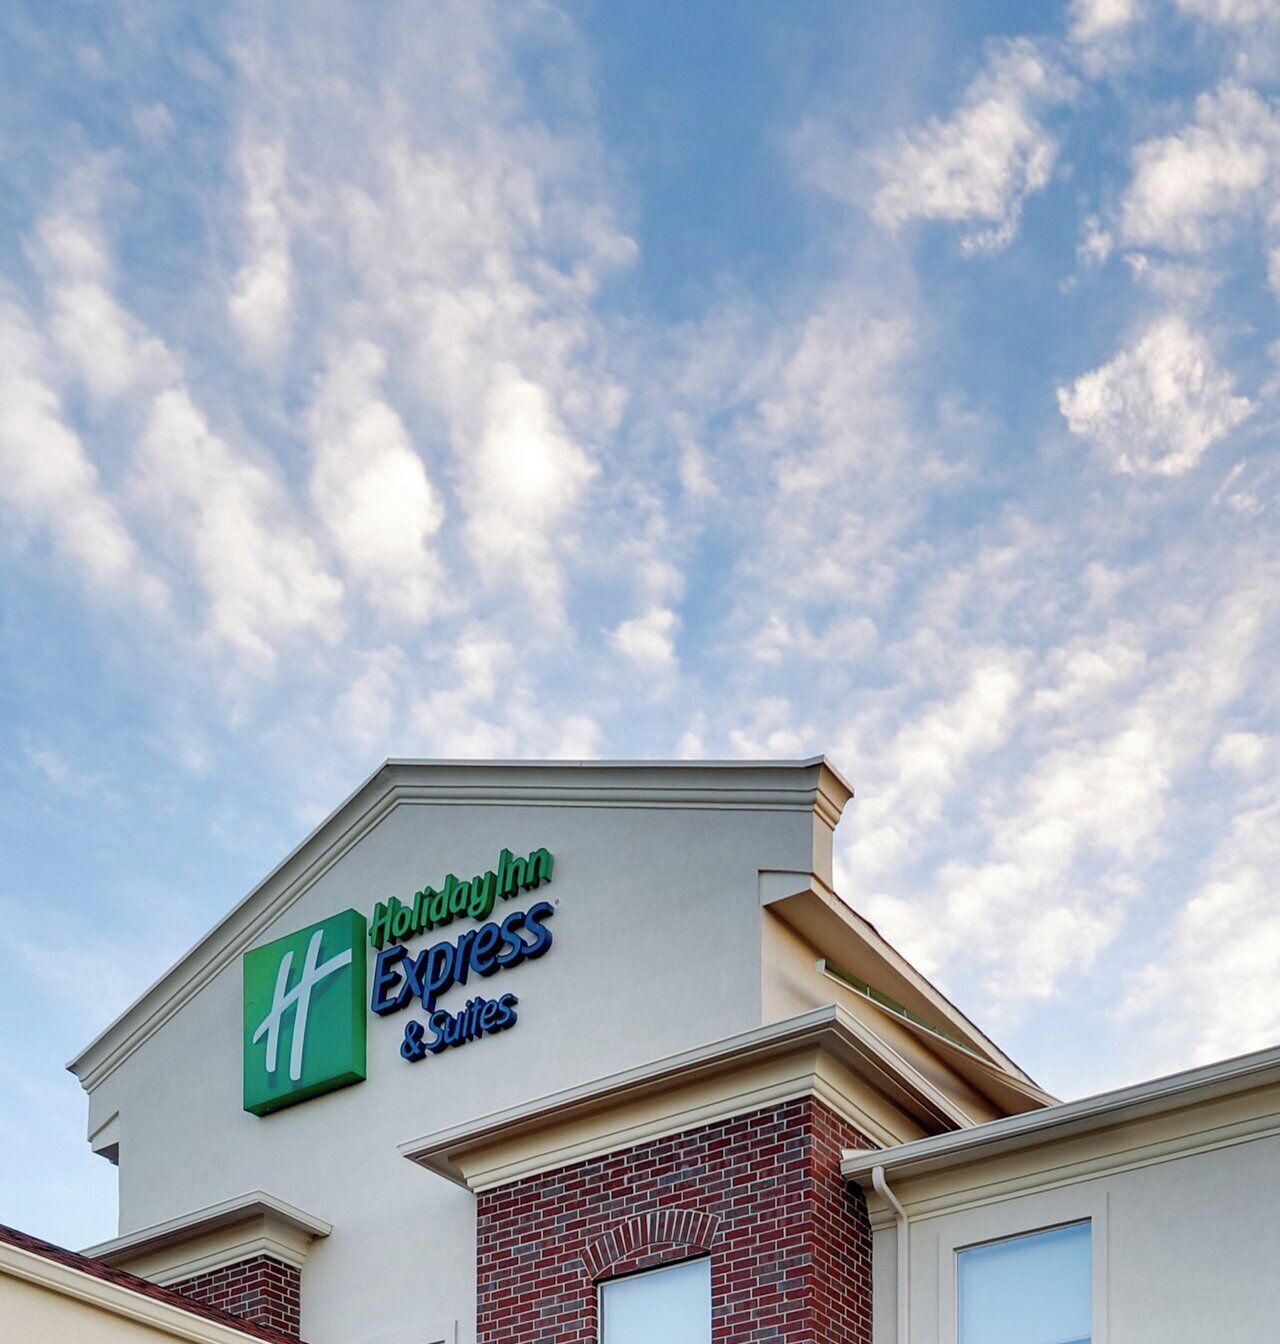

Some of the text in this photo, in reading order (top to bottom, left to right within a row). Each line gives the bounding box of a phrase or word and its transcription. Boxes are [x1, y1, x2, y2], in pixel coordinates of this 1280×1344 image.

[369, 848, 554, 950] Holiday Inn
[371, 901, 554, 1017] Express
[400, 993, 518, 1063] & Suites
